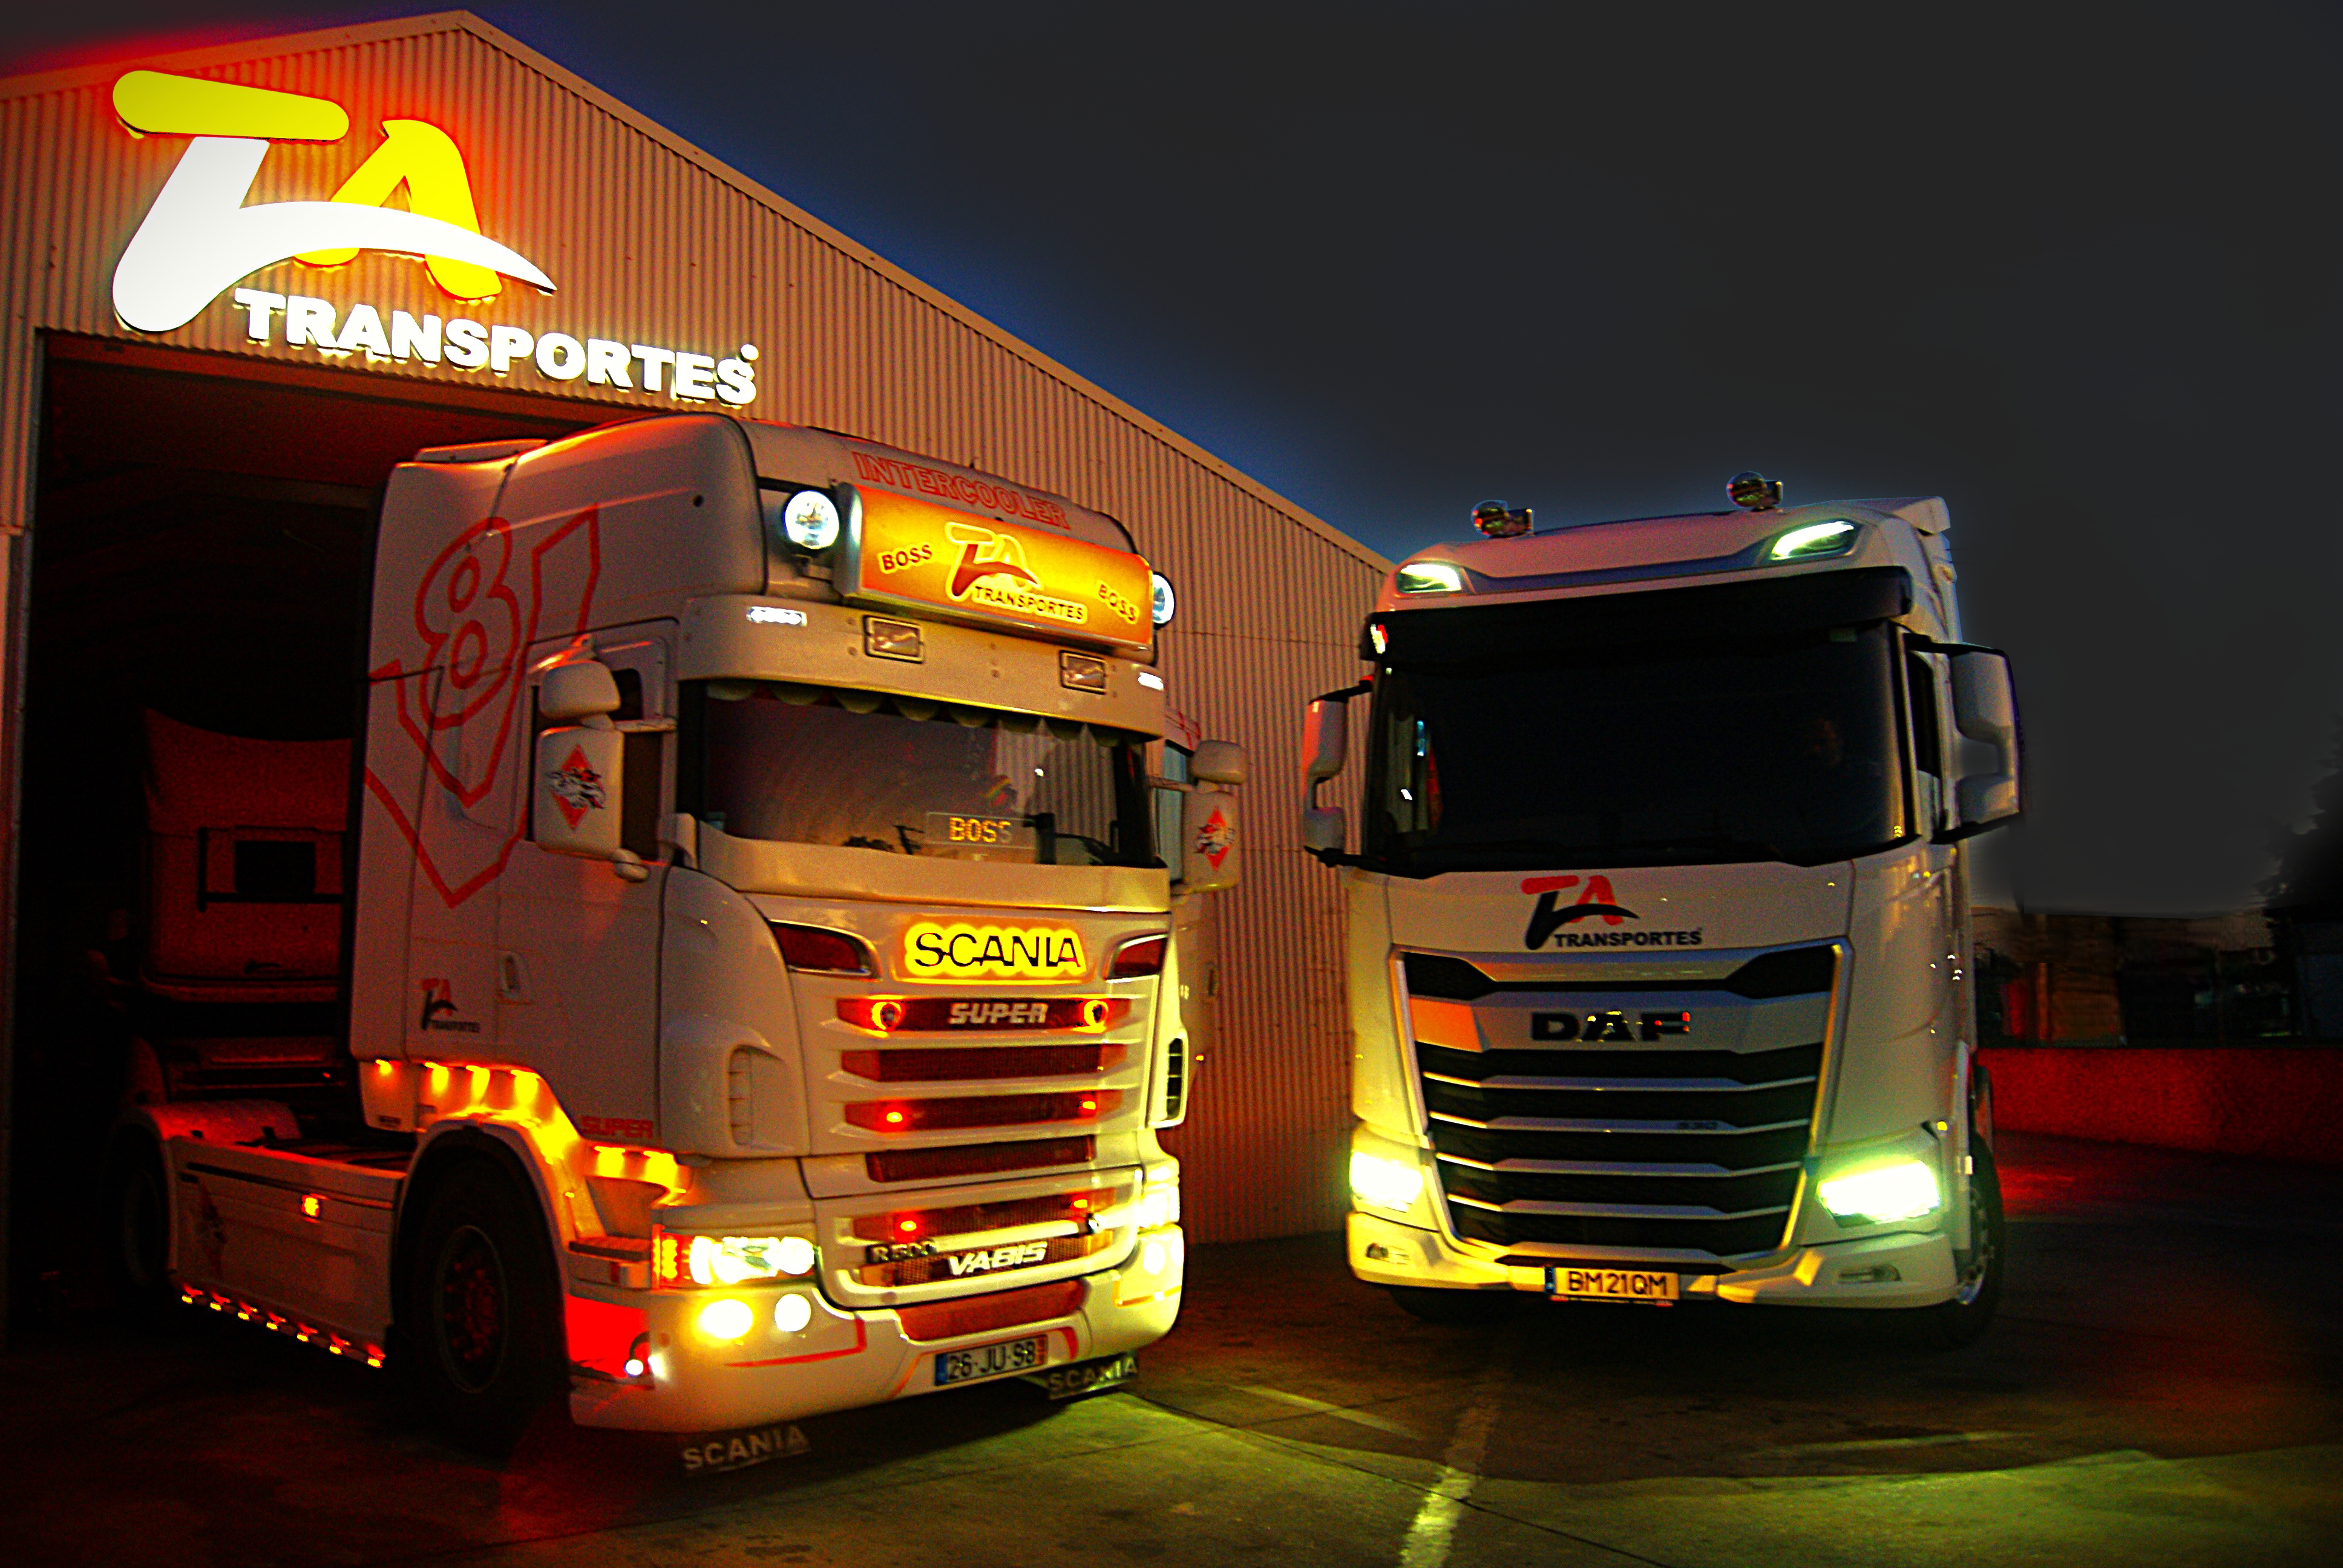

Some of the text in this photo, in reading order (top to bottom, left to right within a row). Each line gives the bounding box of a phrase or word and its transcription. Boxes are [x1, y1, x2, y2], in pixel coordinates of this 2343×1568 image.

[235, 287, 758, 406] TRANSPORTES
[851, 451, 1070, 530] INTERCOOLER
[881, 544, 933, 571] BOSS
[974, 585, 1084, 620] TRANSPORTES
[1097, 584, 1138, 622] BOSS
[949, 816, 1012, 844] BOSS
[914, 932, 1081, 968] SCANIA
[1554, 929, 1702, 948] TRANSPORTES
[948, 1002, 1049, 1024] SUPER
[1531, 1011, 1691, 1042] DAF
[581, 1116, 654, 1139] SUPER
[948, 1241, 1048, 1276] VABIS
[1048, 1356, 1138, 1392] SCANIA
[683, 1425, 812, 1471] SCANIA
